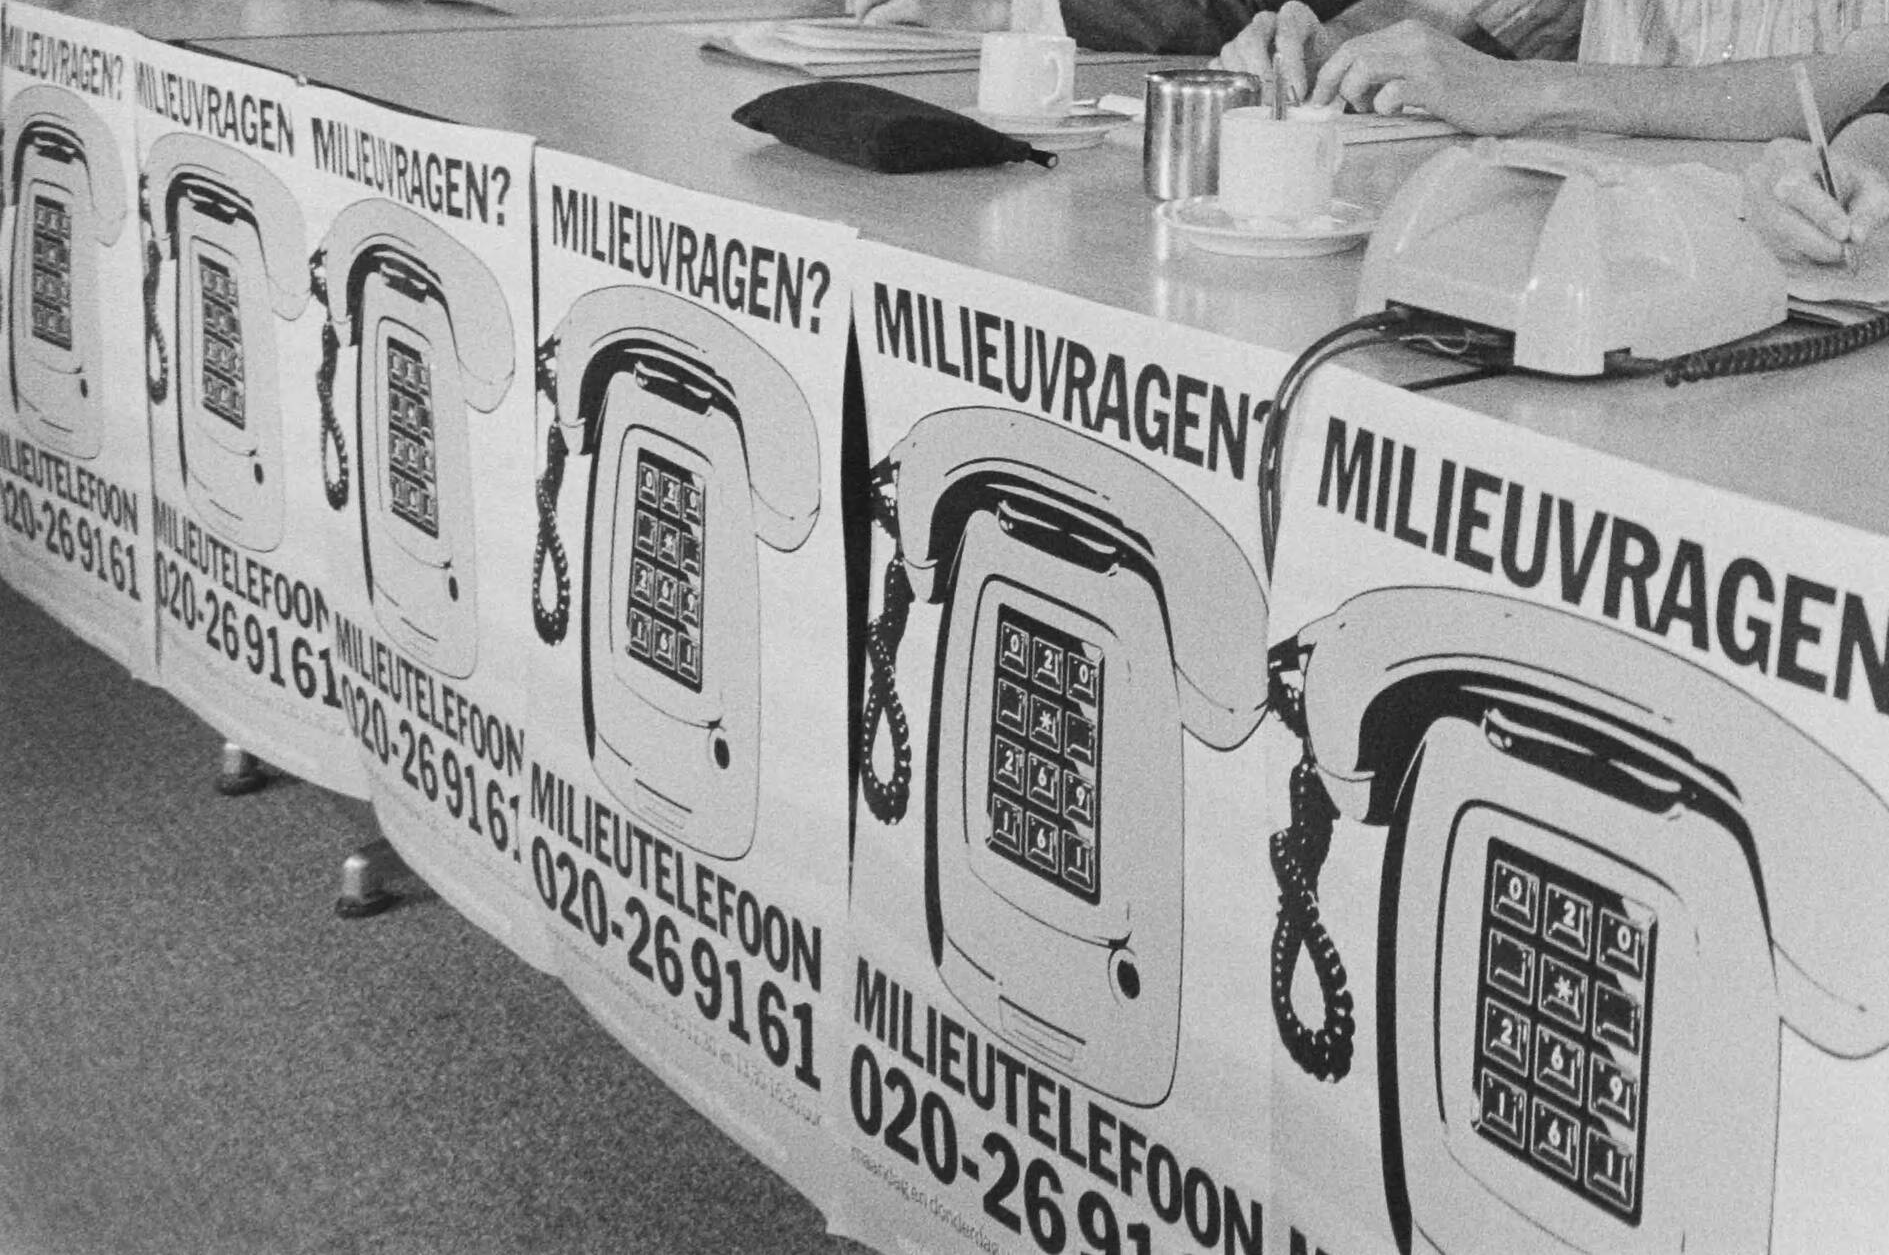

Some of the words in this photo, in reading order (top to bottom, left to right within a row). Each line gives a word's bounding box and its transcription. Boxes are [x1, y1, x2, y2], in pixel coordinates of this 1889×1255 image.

[312, 117, 511, 226] MILIEUVRAGEN?
[552, 184, 831, 334] MILIEUVRAGEN?
[0, 429, 138, 536] ILIEUTELEFOON
[336, 611, 524, 777] MILIEUTELEFOON
[531, 762, 822, 993] MILIEUTELEFOON
[854, 955, 1263, 1255] MILIEUTELEFOON
